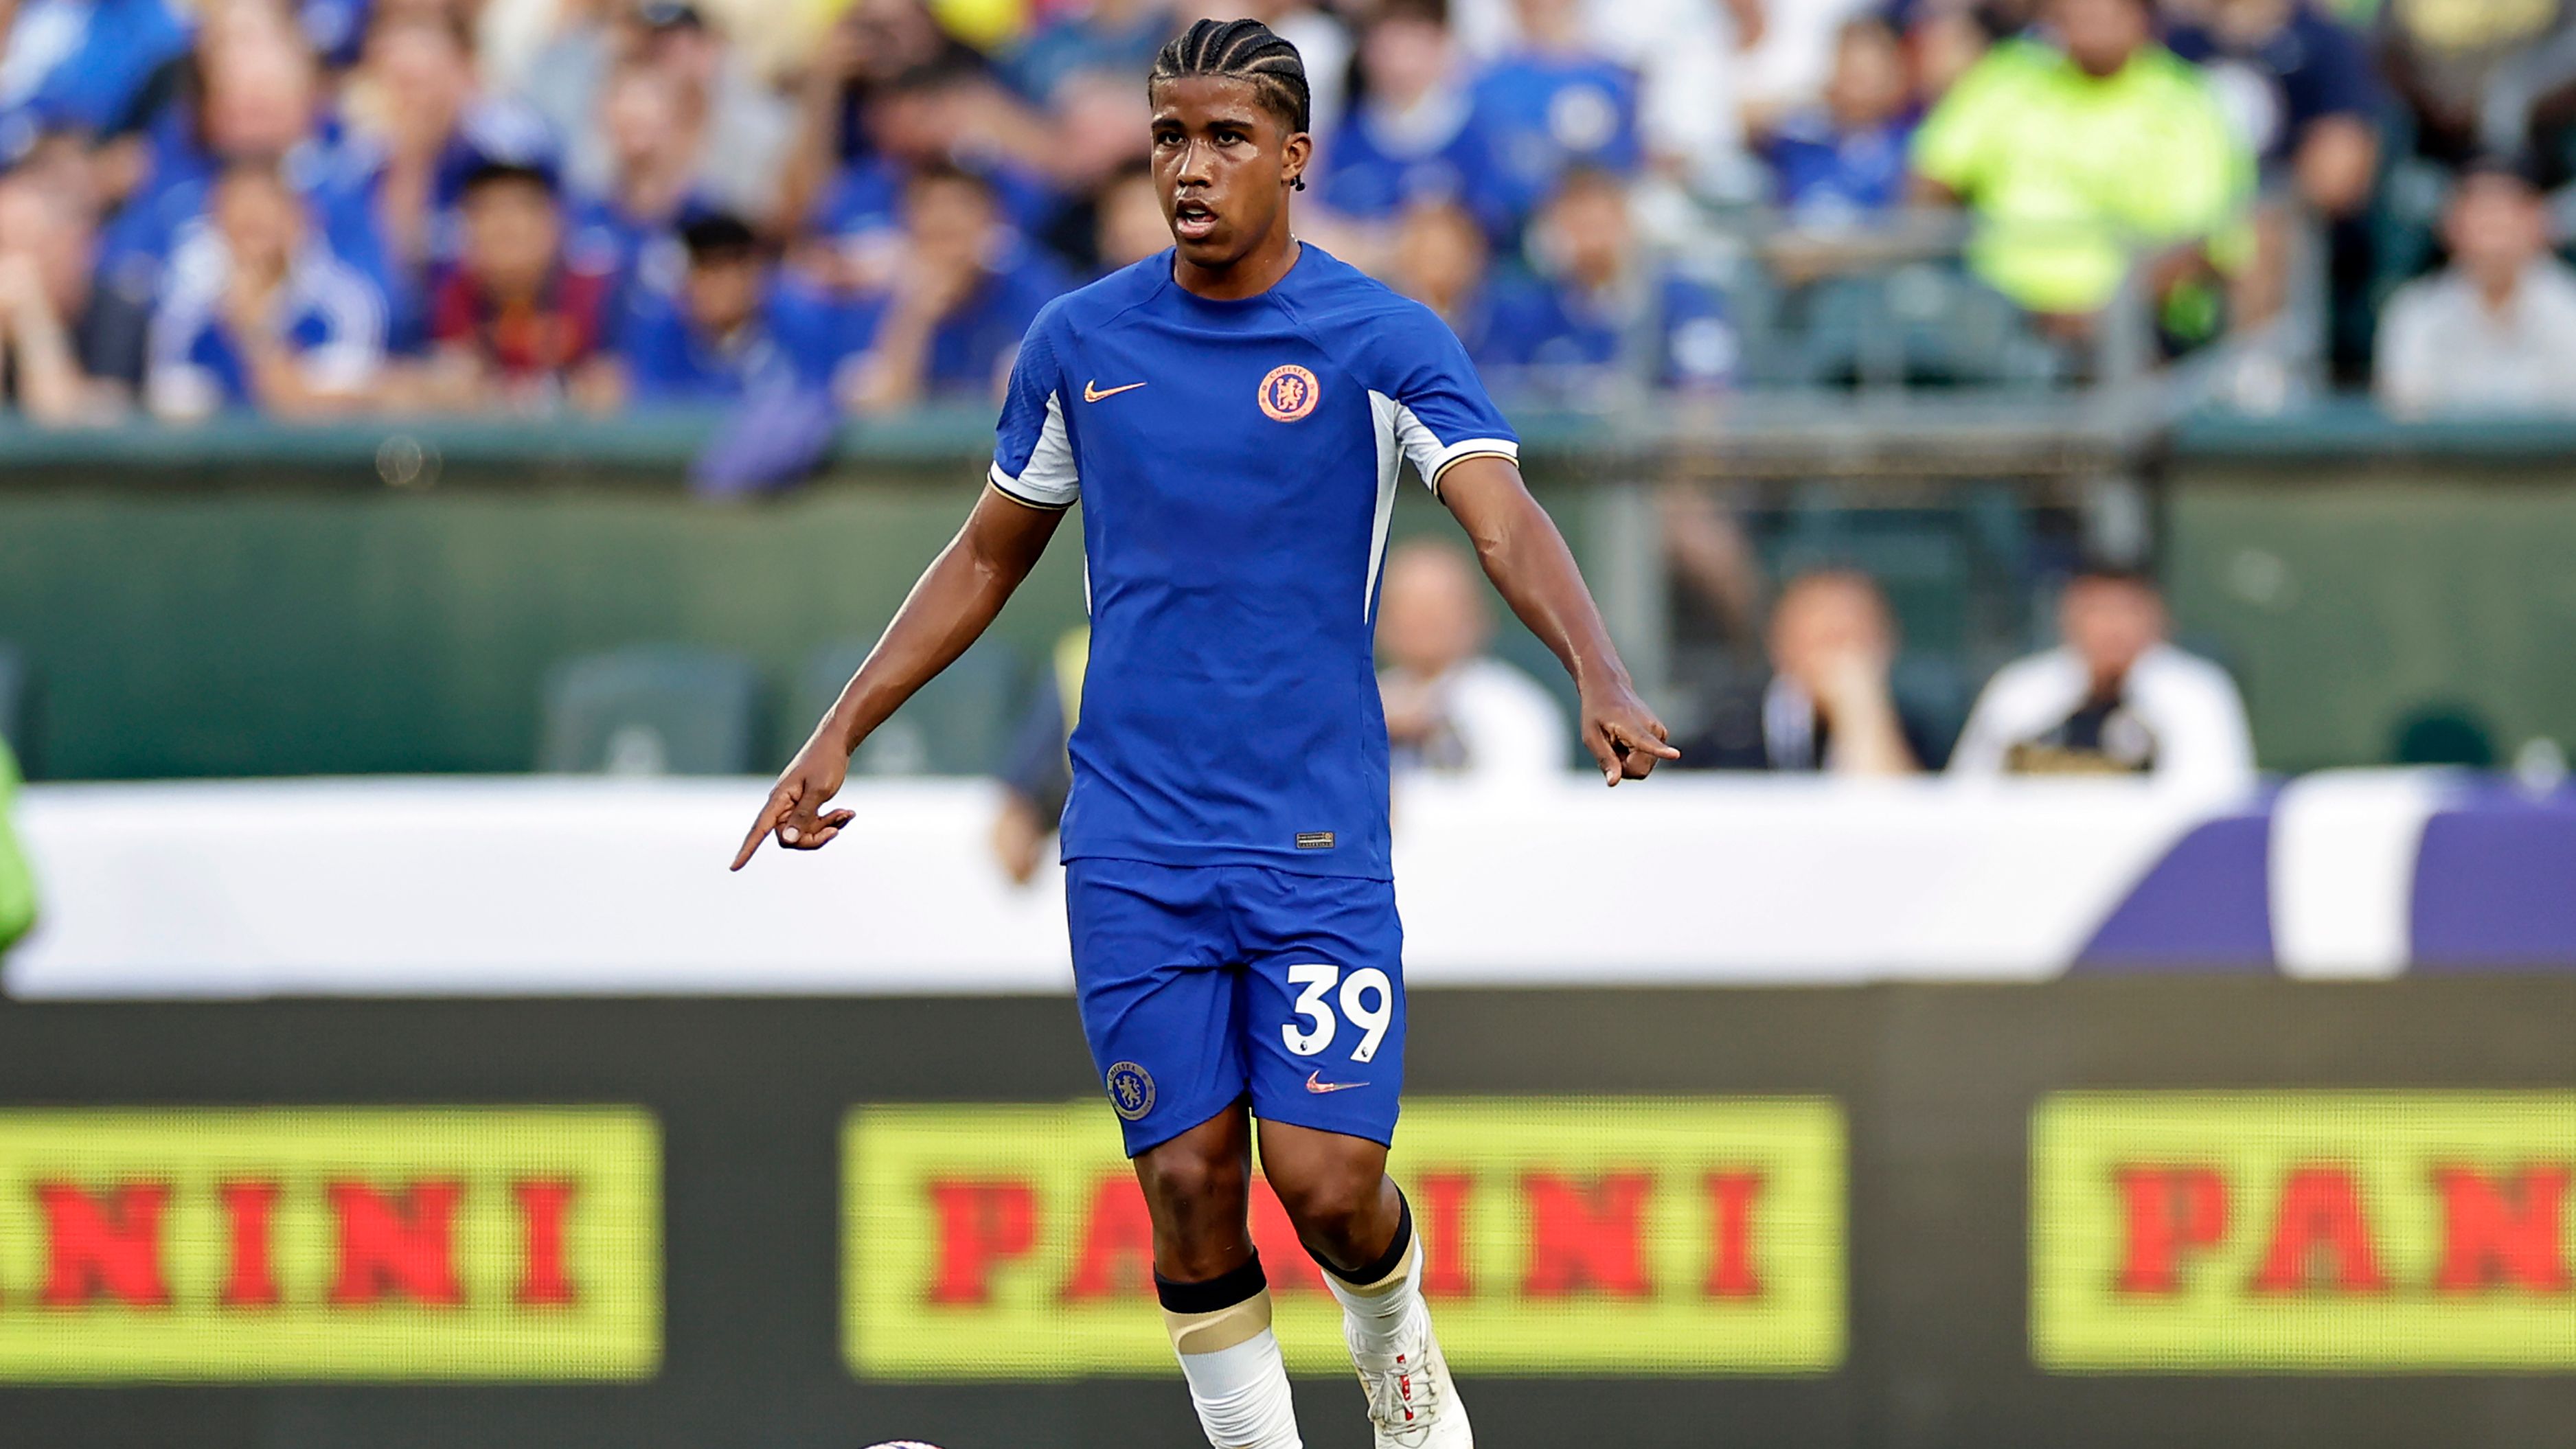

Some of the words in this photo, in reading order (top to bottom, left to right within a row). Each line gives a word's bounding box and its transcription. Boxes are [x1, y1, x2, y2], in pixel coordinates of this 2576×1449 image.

[1281, 963, 1393, 1063] 39
[0, 1176, 575, 1309] NINI
[2115, 1163, 2574, 1297] PAN
